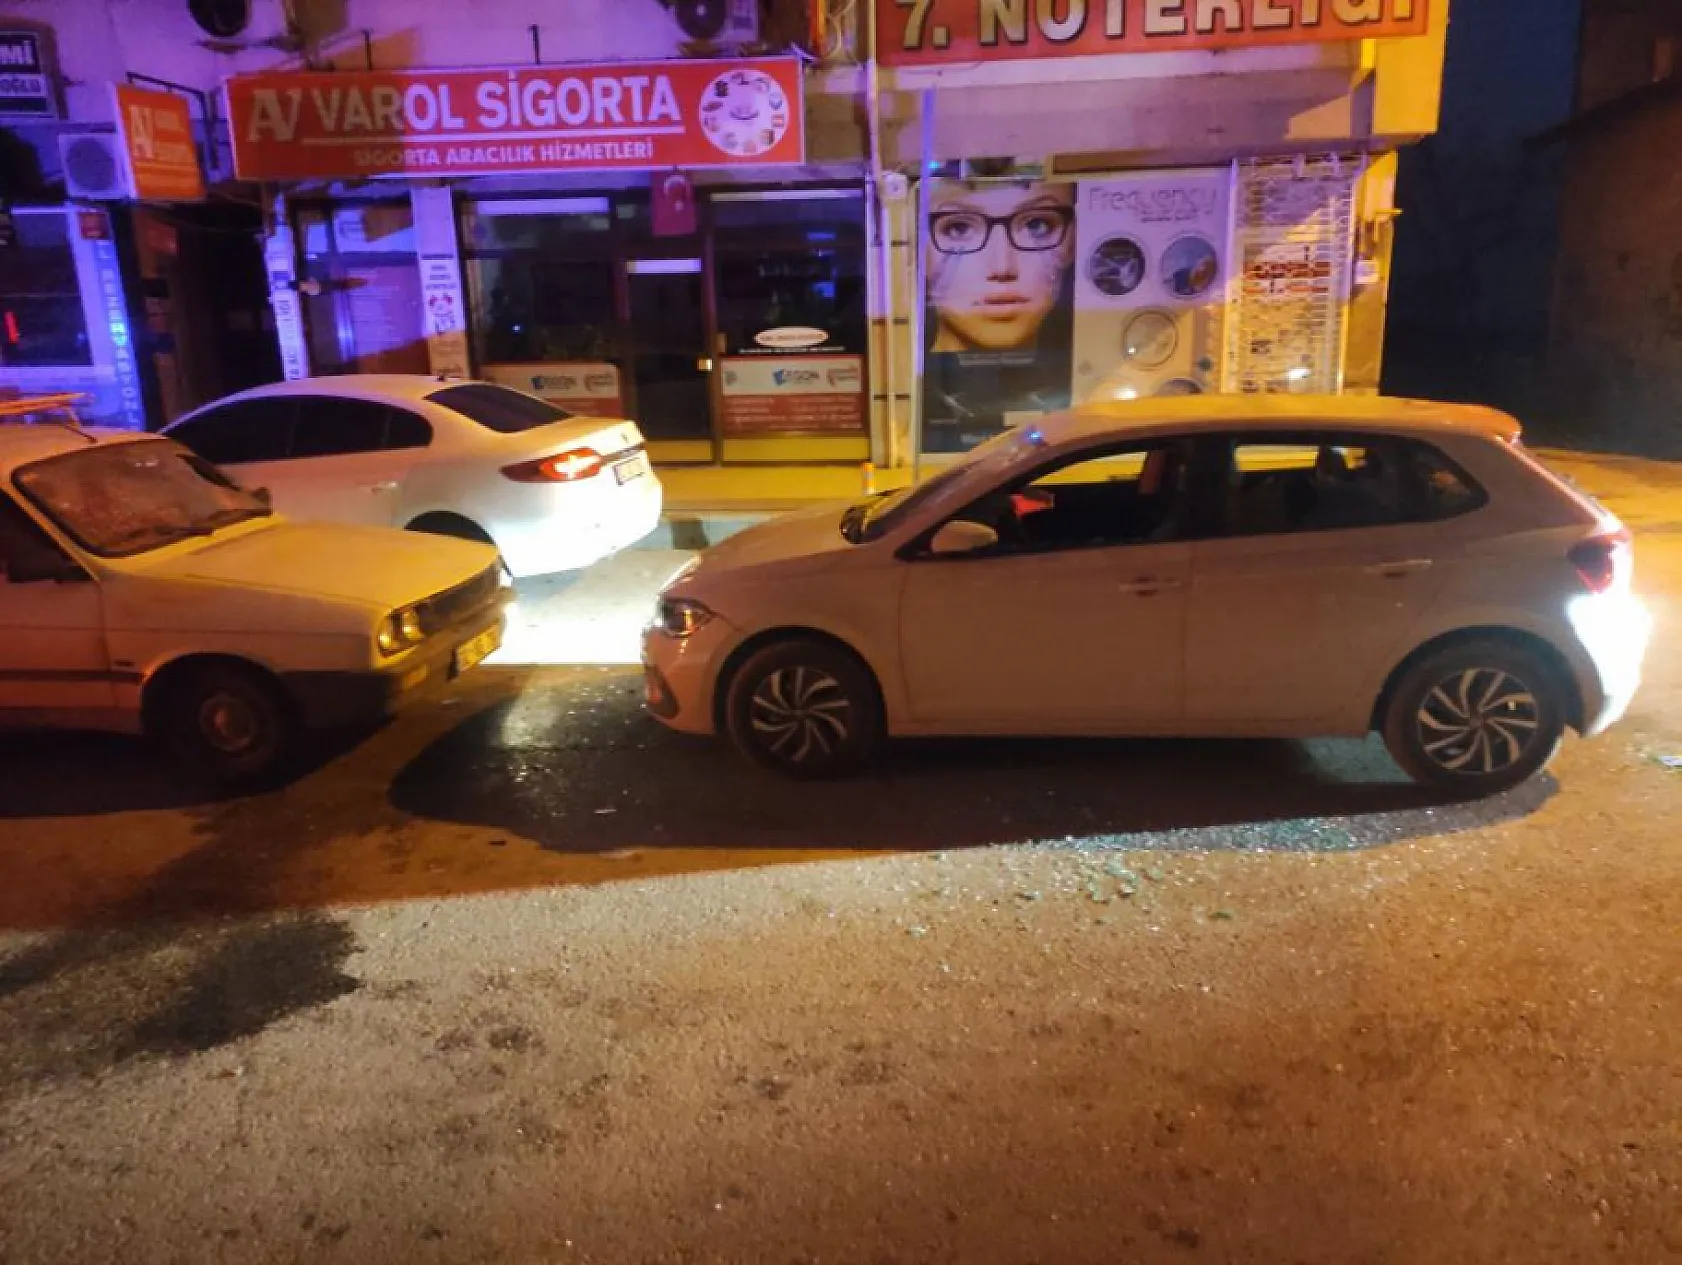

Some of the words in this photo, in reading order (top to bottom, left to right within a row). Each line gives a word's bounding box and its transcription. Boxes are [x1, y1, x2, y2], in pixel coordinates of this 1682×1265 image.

[310, 82, 466, 131] VAROL
[476, 70, 683, 128] SİGORTA
[446, 144, 535, 165] ARACILIK
[541, 137, 653, 161] HİZMETLERİ
